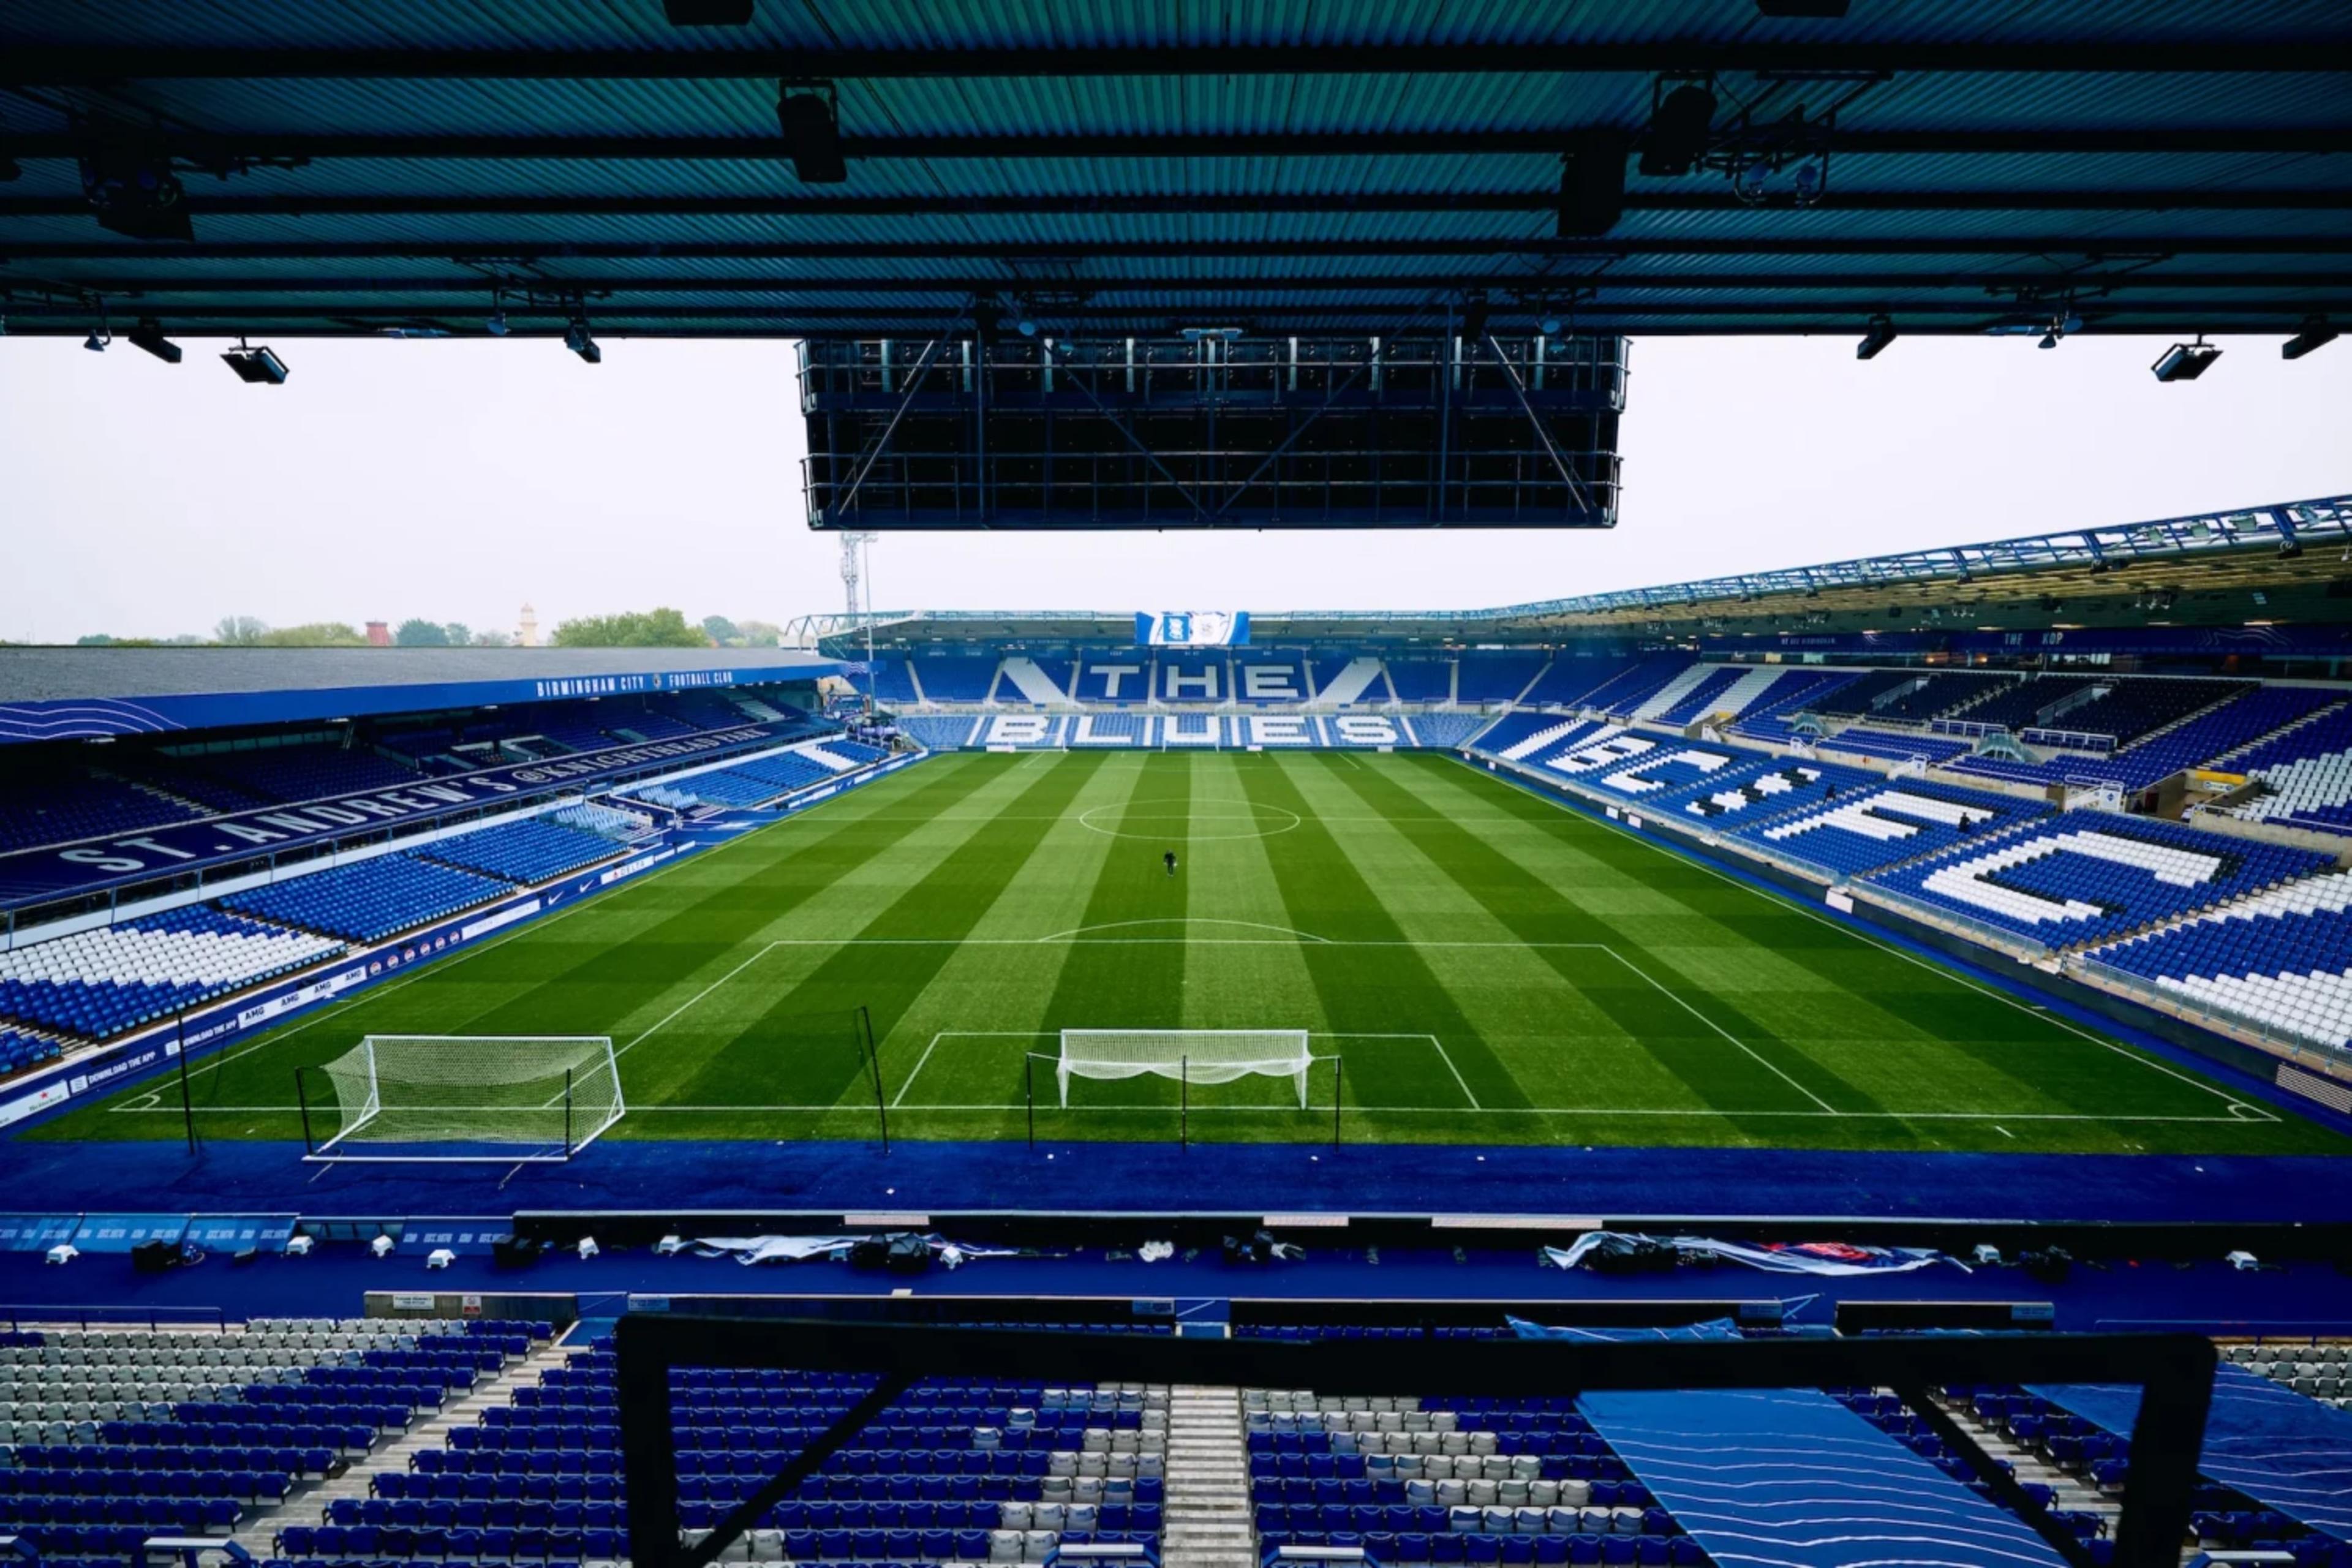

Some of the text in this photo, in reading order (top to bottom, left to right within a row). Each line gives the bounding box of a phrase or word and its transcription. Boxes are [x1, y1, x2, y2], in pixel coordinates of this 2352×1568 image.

[537, 671, 733, 697] BIRMINGHAM CITY FOOTBALL CLUB
[1090, 665, 1298, 698] THE
[985, 715, 1398, 744] BLUES
[245, 1006, 265, 1020] AMG
[88, 1051, 156, 1084] DOWNLOAD THE APP
